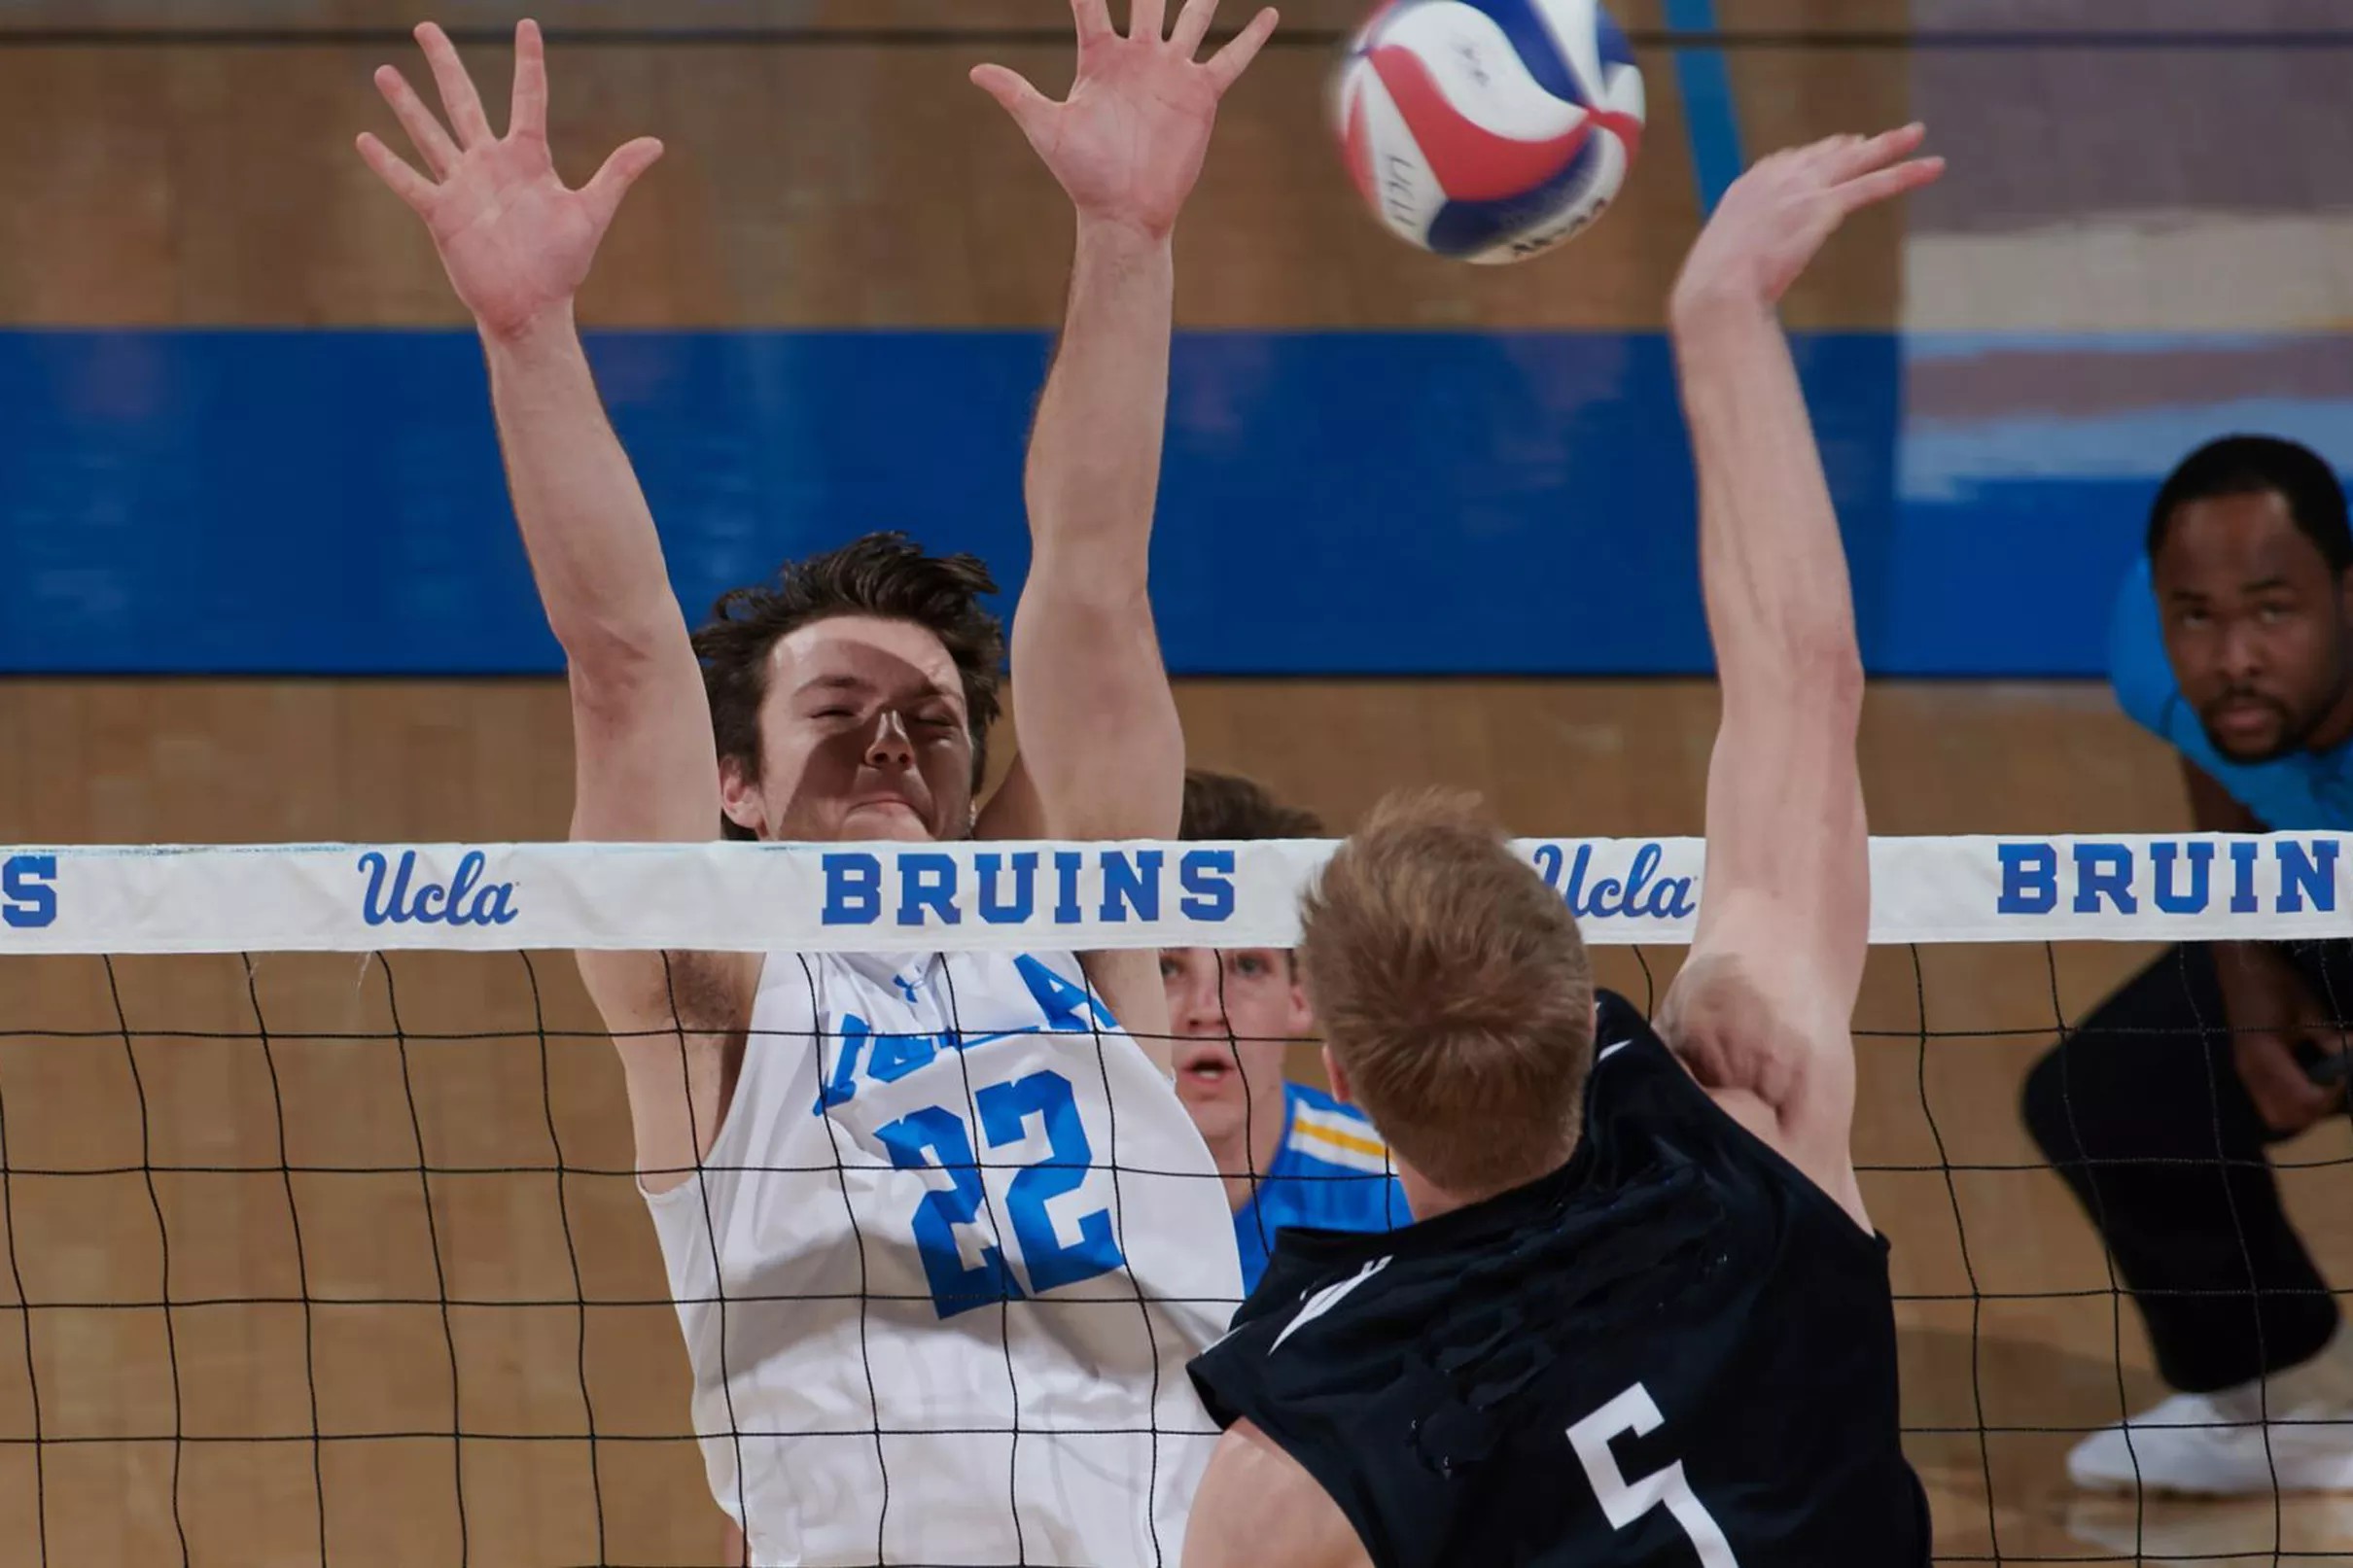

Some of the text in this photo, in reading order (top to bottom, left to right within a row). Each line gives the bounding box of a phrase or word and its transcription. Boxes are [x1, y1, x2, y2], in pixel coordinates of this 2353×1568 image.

[357, 850, 518, 925] Ucla
[822, 851, 1235, 925] BRUINS
[1533, 843, 1696, 920] Ucla
[1997, 840, 2339, 915] BRUIN
[872, 1069, 1128, 1320] 22
